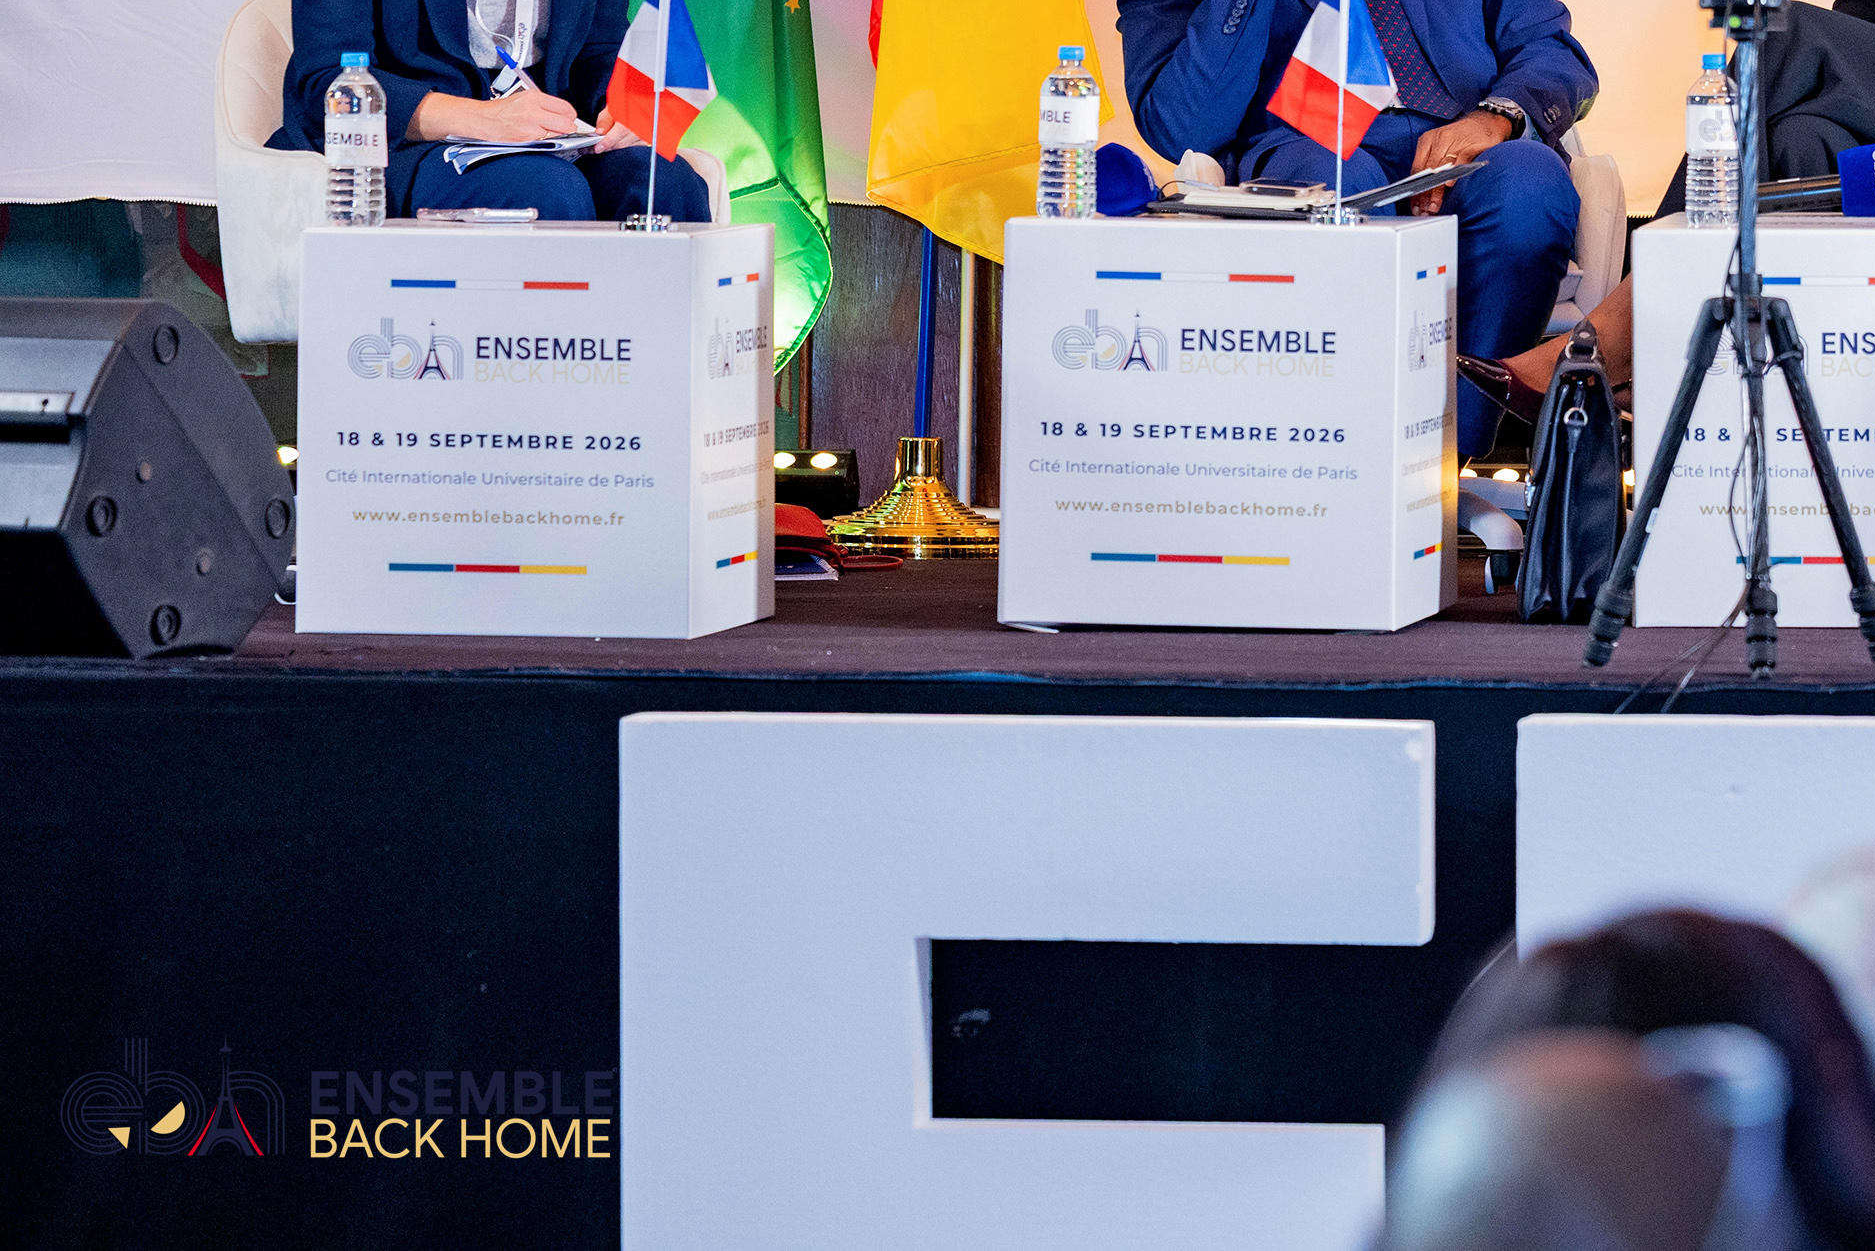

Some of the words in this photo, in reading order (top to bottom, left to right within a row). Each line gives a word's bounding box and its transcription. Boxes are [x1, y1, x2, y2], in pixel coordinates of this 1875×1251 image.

[326, 132, 378, 147] SEMBLE
[477, 337, 631, 361] ENSEMBLE
[1181, 329, 1335, 354] ENSEMBLE
[337, 431, 360, 447] 18
[371, 432, 385, 447] &
[396, 432, 418, 448] 19
[429, 432, 573, 450] SEPTEMBRE
[585, 435, 641, 451] 2026
[1040, 421, 1064, 437] 18
[1074, 422, 1088, 437] &
[1099, 422, 1122, 438] 19
[1133, 423, 1277, 442] SEPTEMBRE
[1289, 427, 1345, 443] 2026
[1717, 427, 1732, 443] &
[325, 469, 358, 484] Cité
[362, 470, 477, 486] Internationale
[481, 472, 585, 487] Universitaire
[587, 473, 610, 488] de
[613, 473, 655, 489] Paris
[1028, 458, 1062, 473] Cité
[1065, 460, 1181, 476] Internationale
[1184, 463, 1288, 479] Universitaire
[1291, 465, 1314, 480] de
[1317, 465, 1358, 481] Paris
[1670, 464, 1706, 480] Cité
[352, 509, 625, 526] www.ensemblebackhome.fr
[1054, 500, 1328, 518] www.ensemblebackhome.fr
